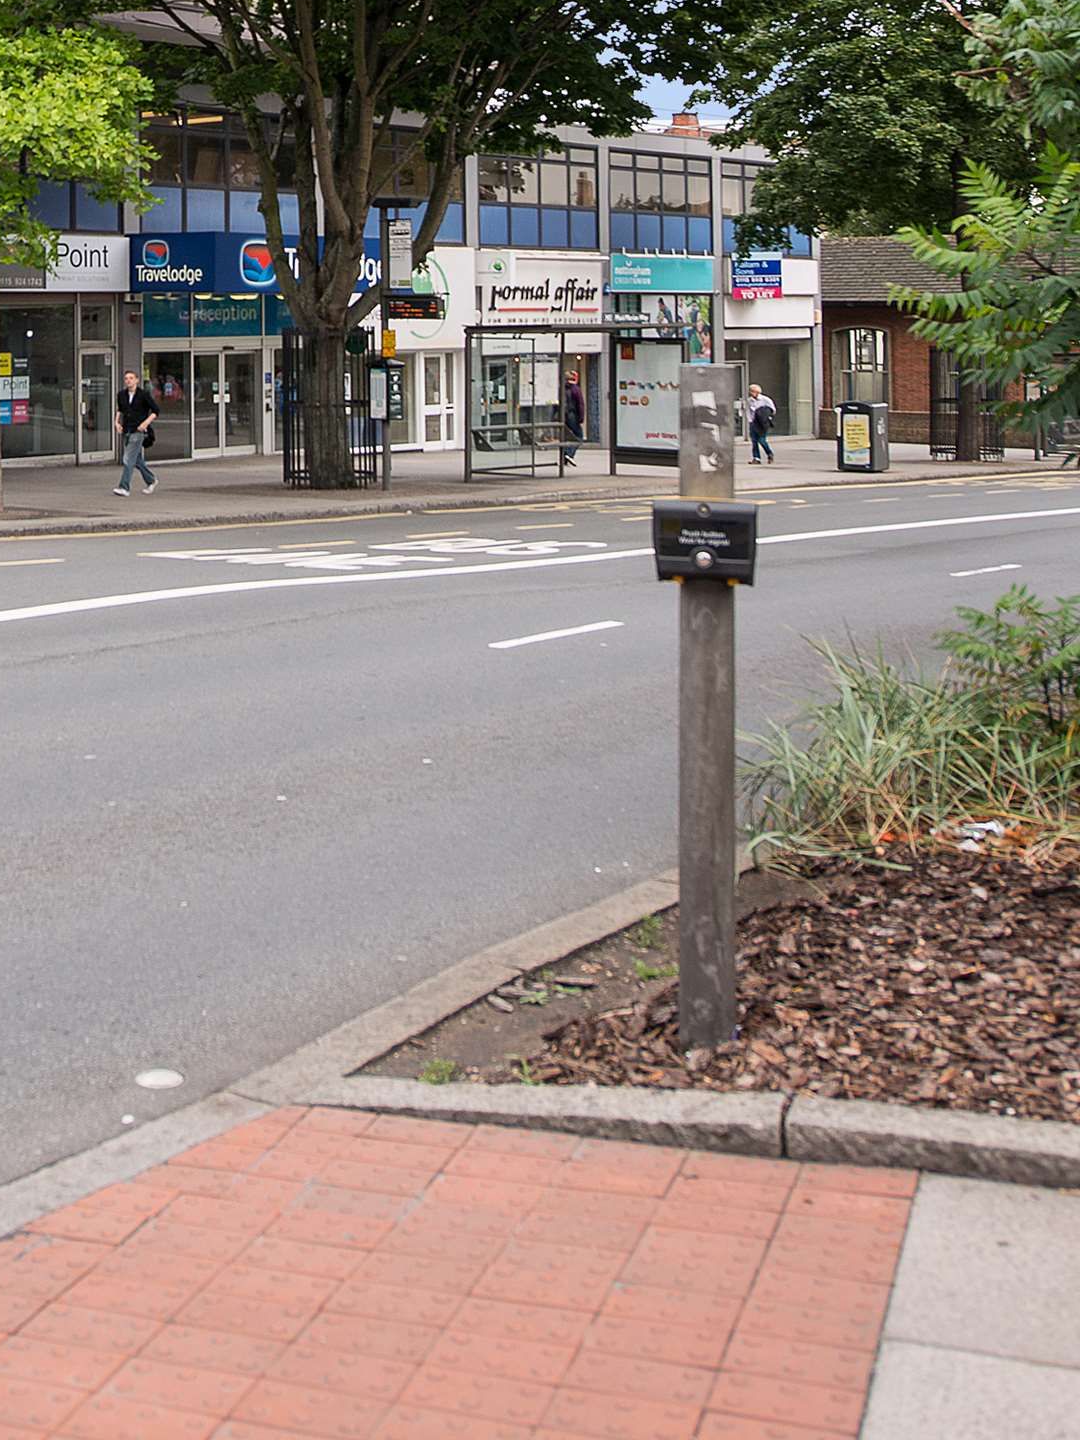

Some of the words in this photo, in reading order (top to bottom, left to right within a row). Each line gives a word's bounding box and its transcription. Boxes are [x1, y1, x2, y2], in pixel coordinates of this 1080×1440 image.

[55, 243, 109, 268] Point
[135, 264, 203, 285] Travelodge
[554, 278, 598, 312] affair
[741, 291, 755, 299] TO
[194, 304, 257, 325] reception
